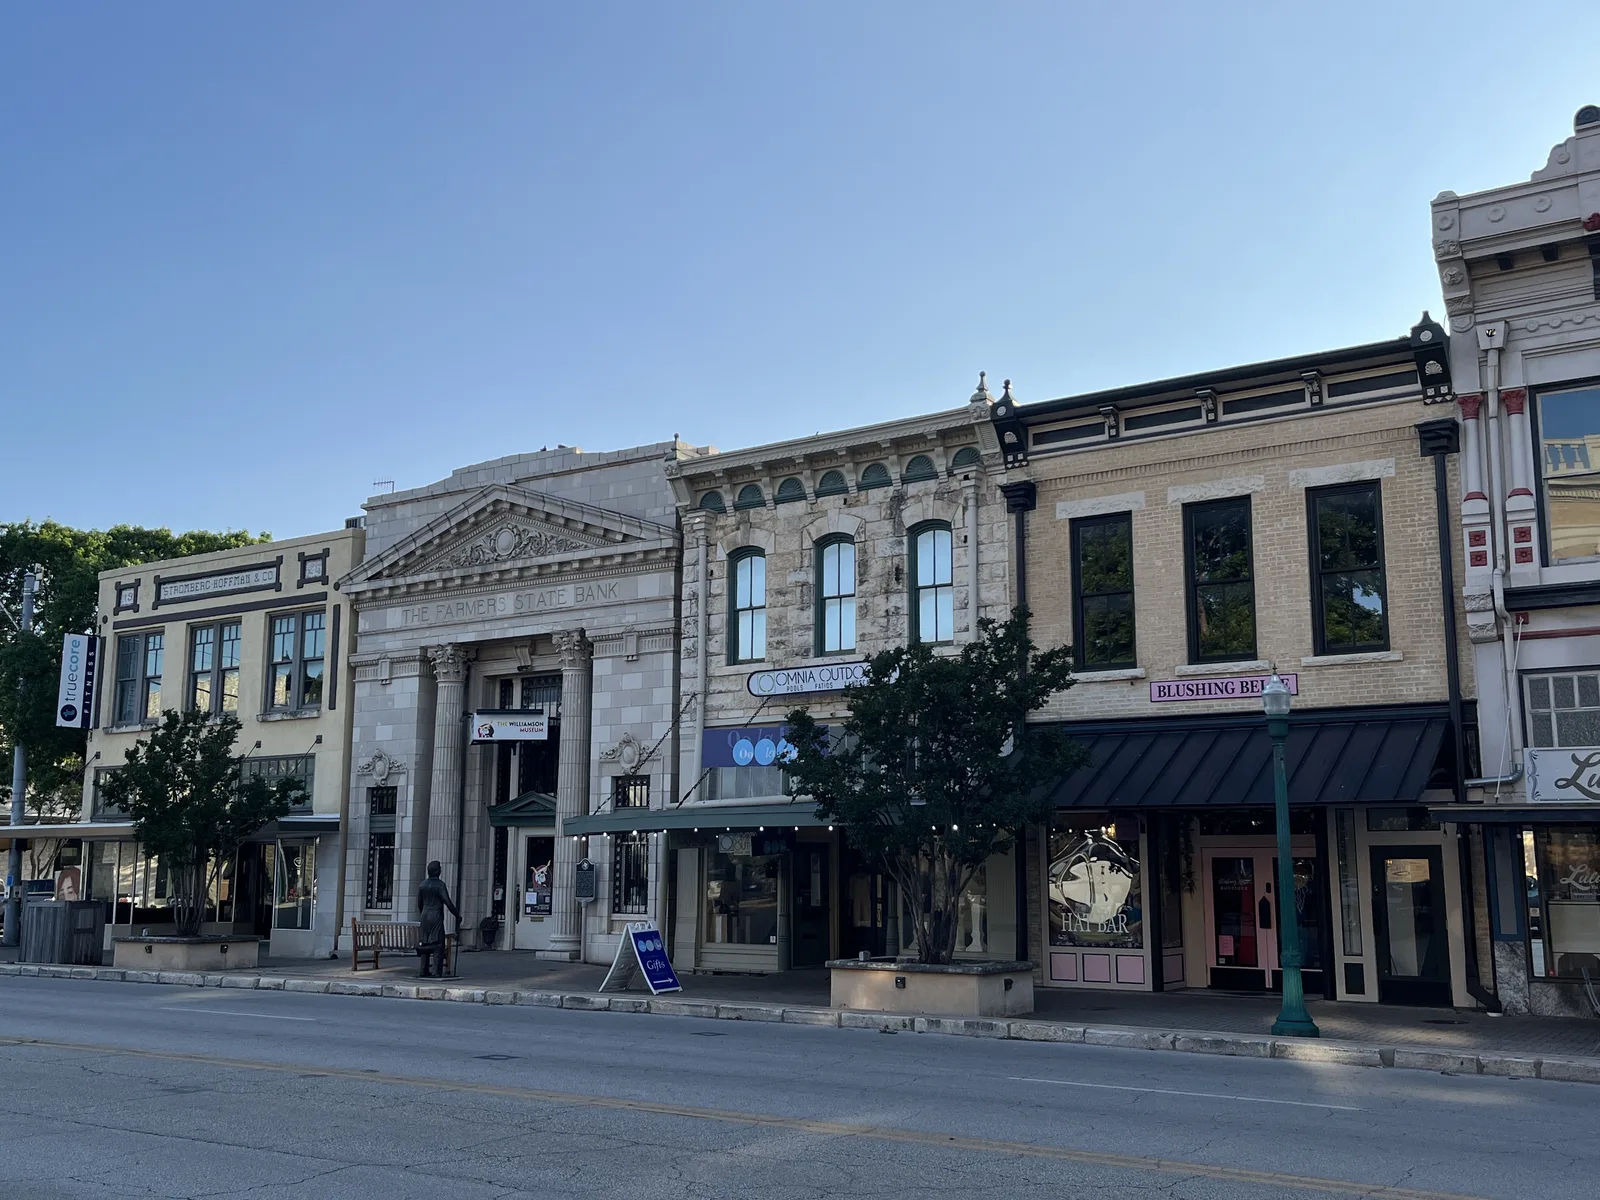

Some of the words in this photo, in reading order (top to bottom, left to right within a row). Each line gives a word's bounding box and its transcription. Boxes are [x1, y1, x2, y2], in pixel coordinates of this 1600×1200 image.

[402, 607, 430, 624] THE
[513, 589, 567, 610] STATE
[574, 582, 619, 603] BANK
[65, 639, 80, 702] truecore
[775, 671, 816, 686] OMNIA
[819, 665, 871, 682] OUTDO
[84, 651, 94, 714] FITNESS
[786, 684, 804, 692] POOLS
[815, 682, 833, 690] PATIOS
[1157, 681, 1235, 698] BLUSHING
[1240, 678, 1290, 694] BELE
[1061, 912, 1091, 932] HAT
[646, 958, 666, 972] Gifts
